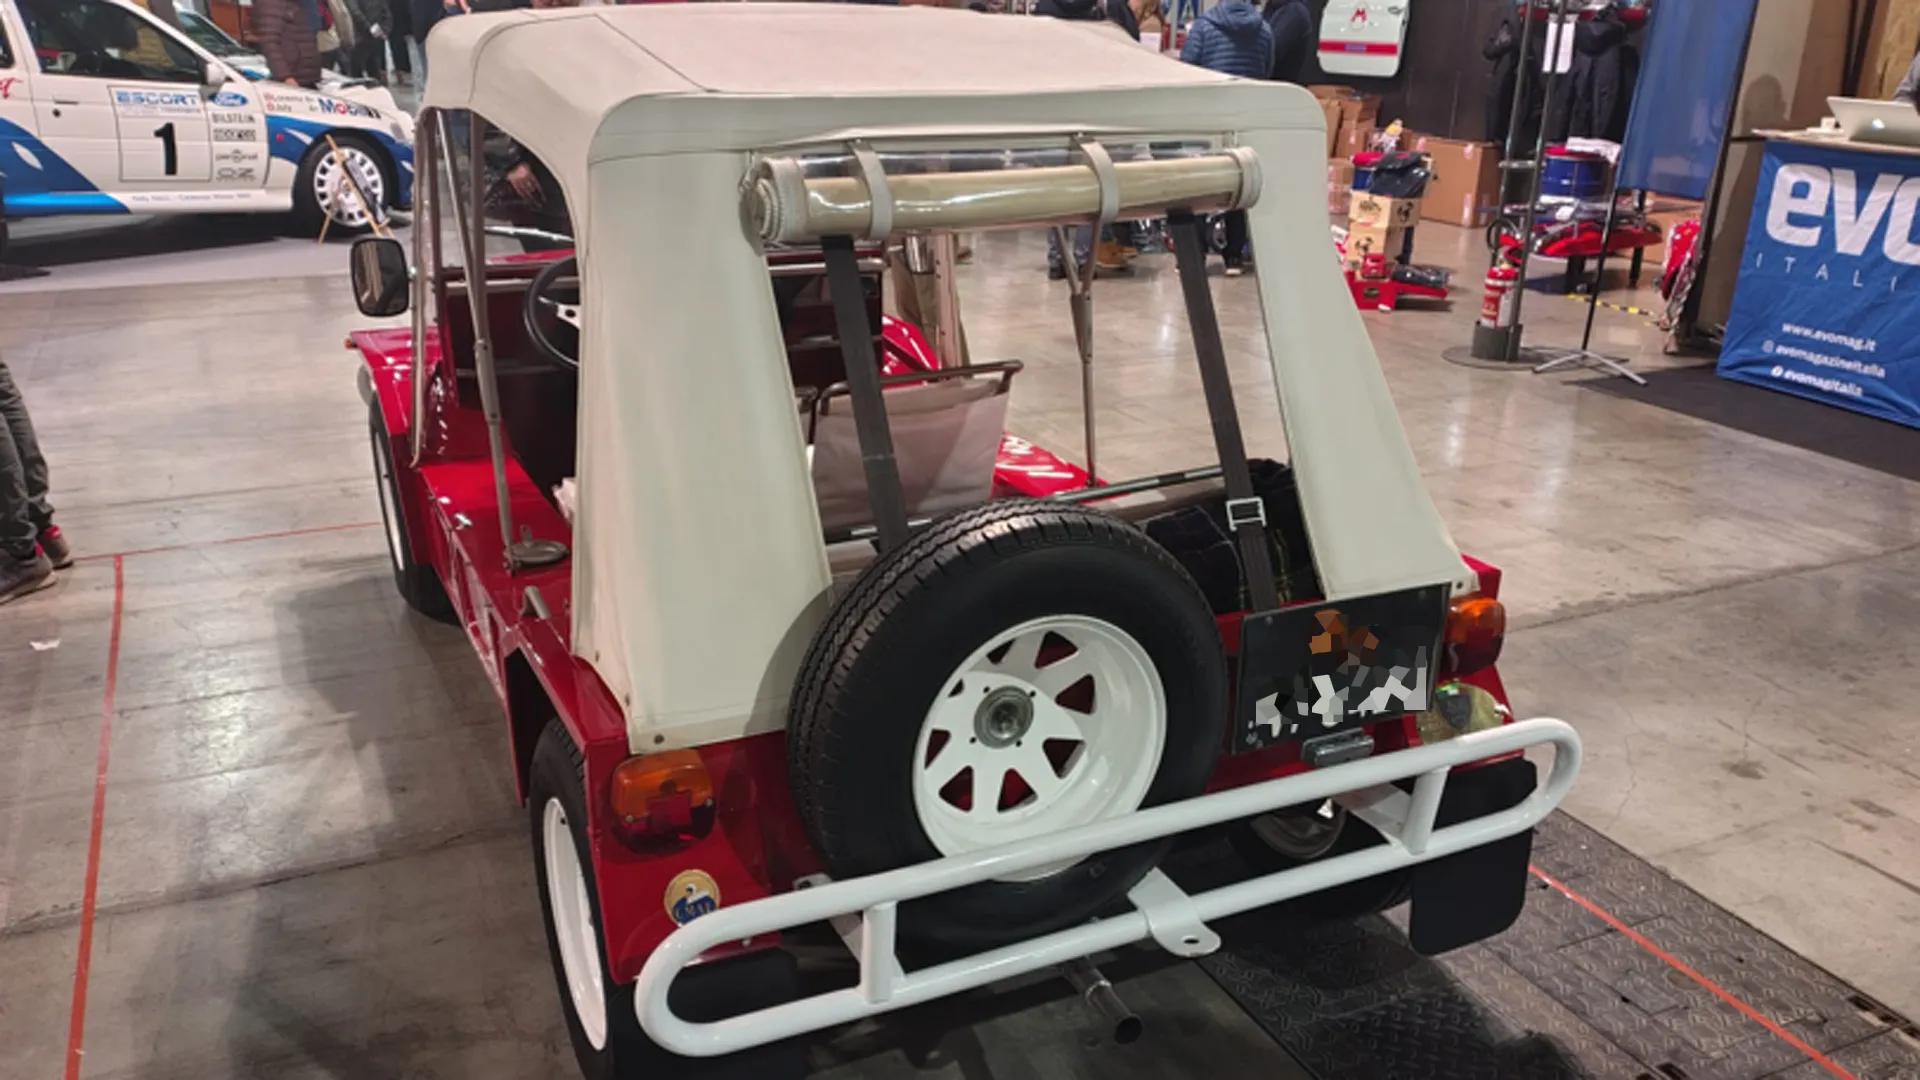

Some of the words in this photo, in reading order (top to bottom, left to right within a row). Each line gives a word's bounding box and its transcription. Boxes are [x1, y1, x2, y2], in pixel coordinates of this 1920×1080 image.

[115, 91, 199, 105] ESCORT
[154, 122, 178, 176] 1
[1766, 163, 1920, 266] evo
[1782, 323, 1876, 352] www.evomag.it
